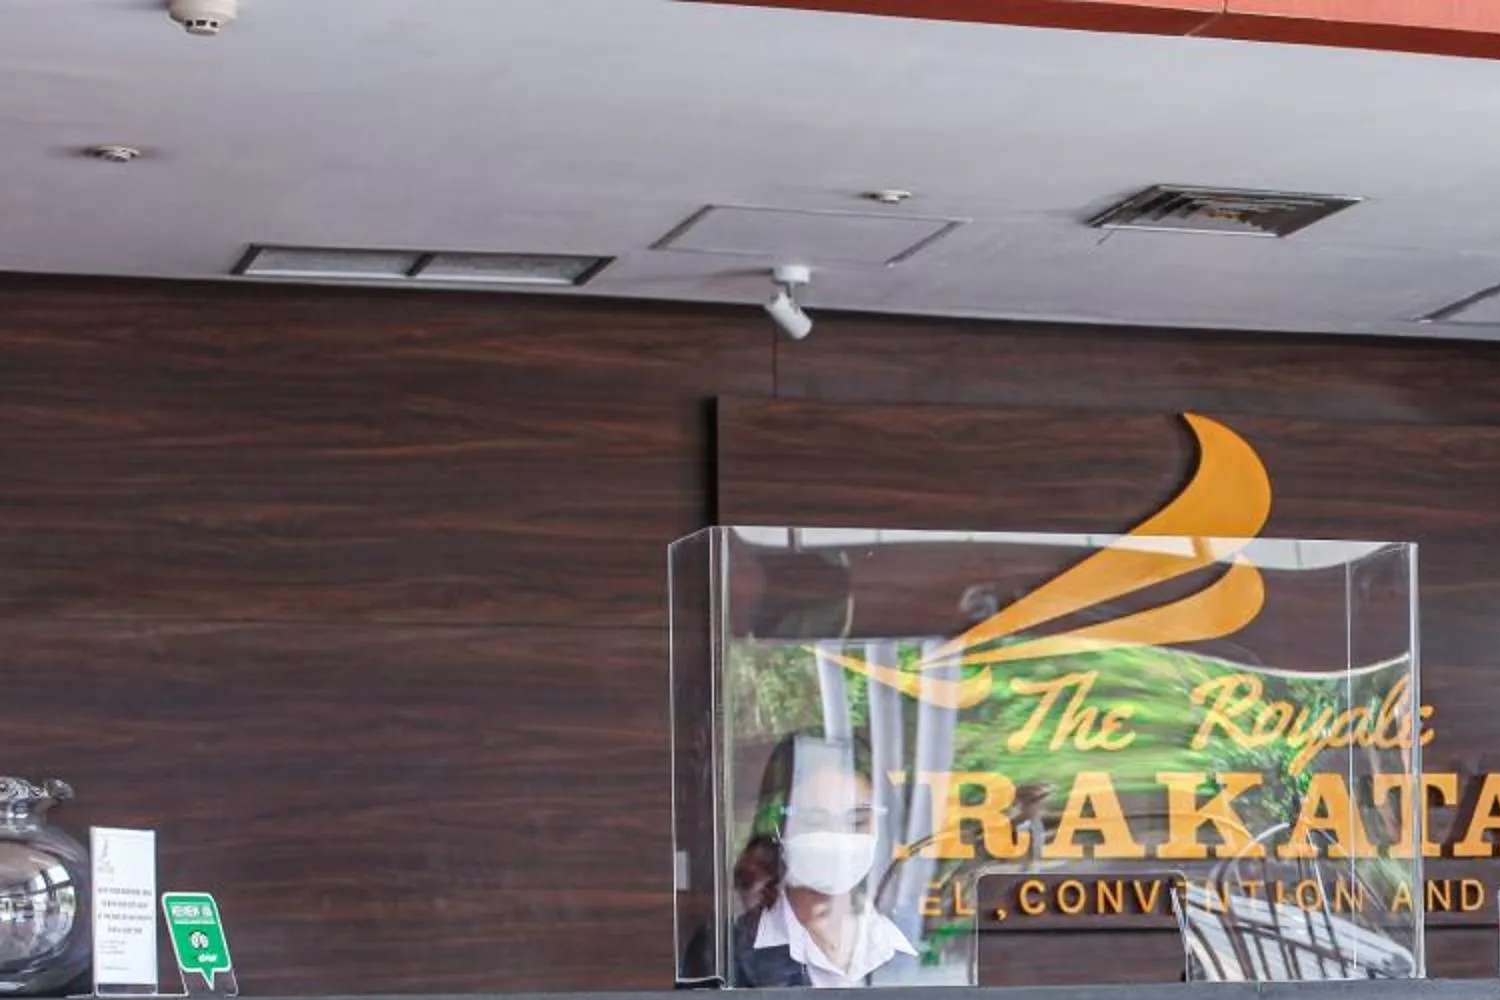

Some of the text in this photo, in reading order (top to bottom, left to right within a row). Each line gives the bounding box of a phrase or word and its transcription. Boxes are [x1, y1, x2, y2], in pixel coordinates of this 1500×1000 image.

[1007, 670, 1436, 777] The Royale
[1391, 878, 1485, 913] AND
